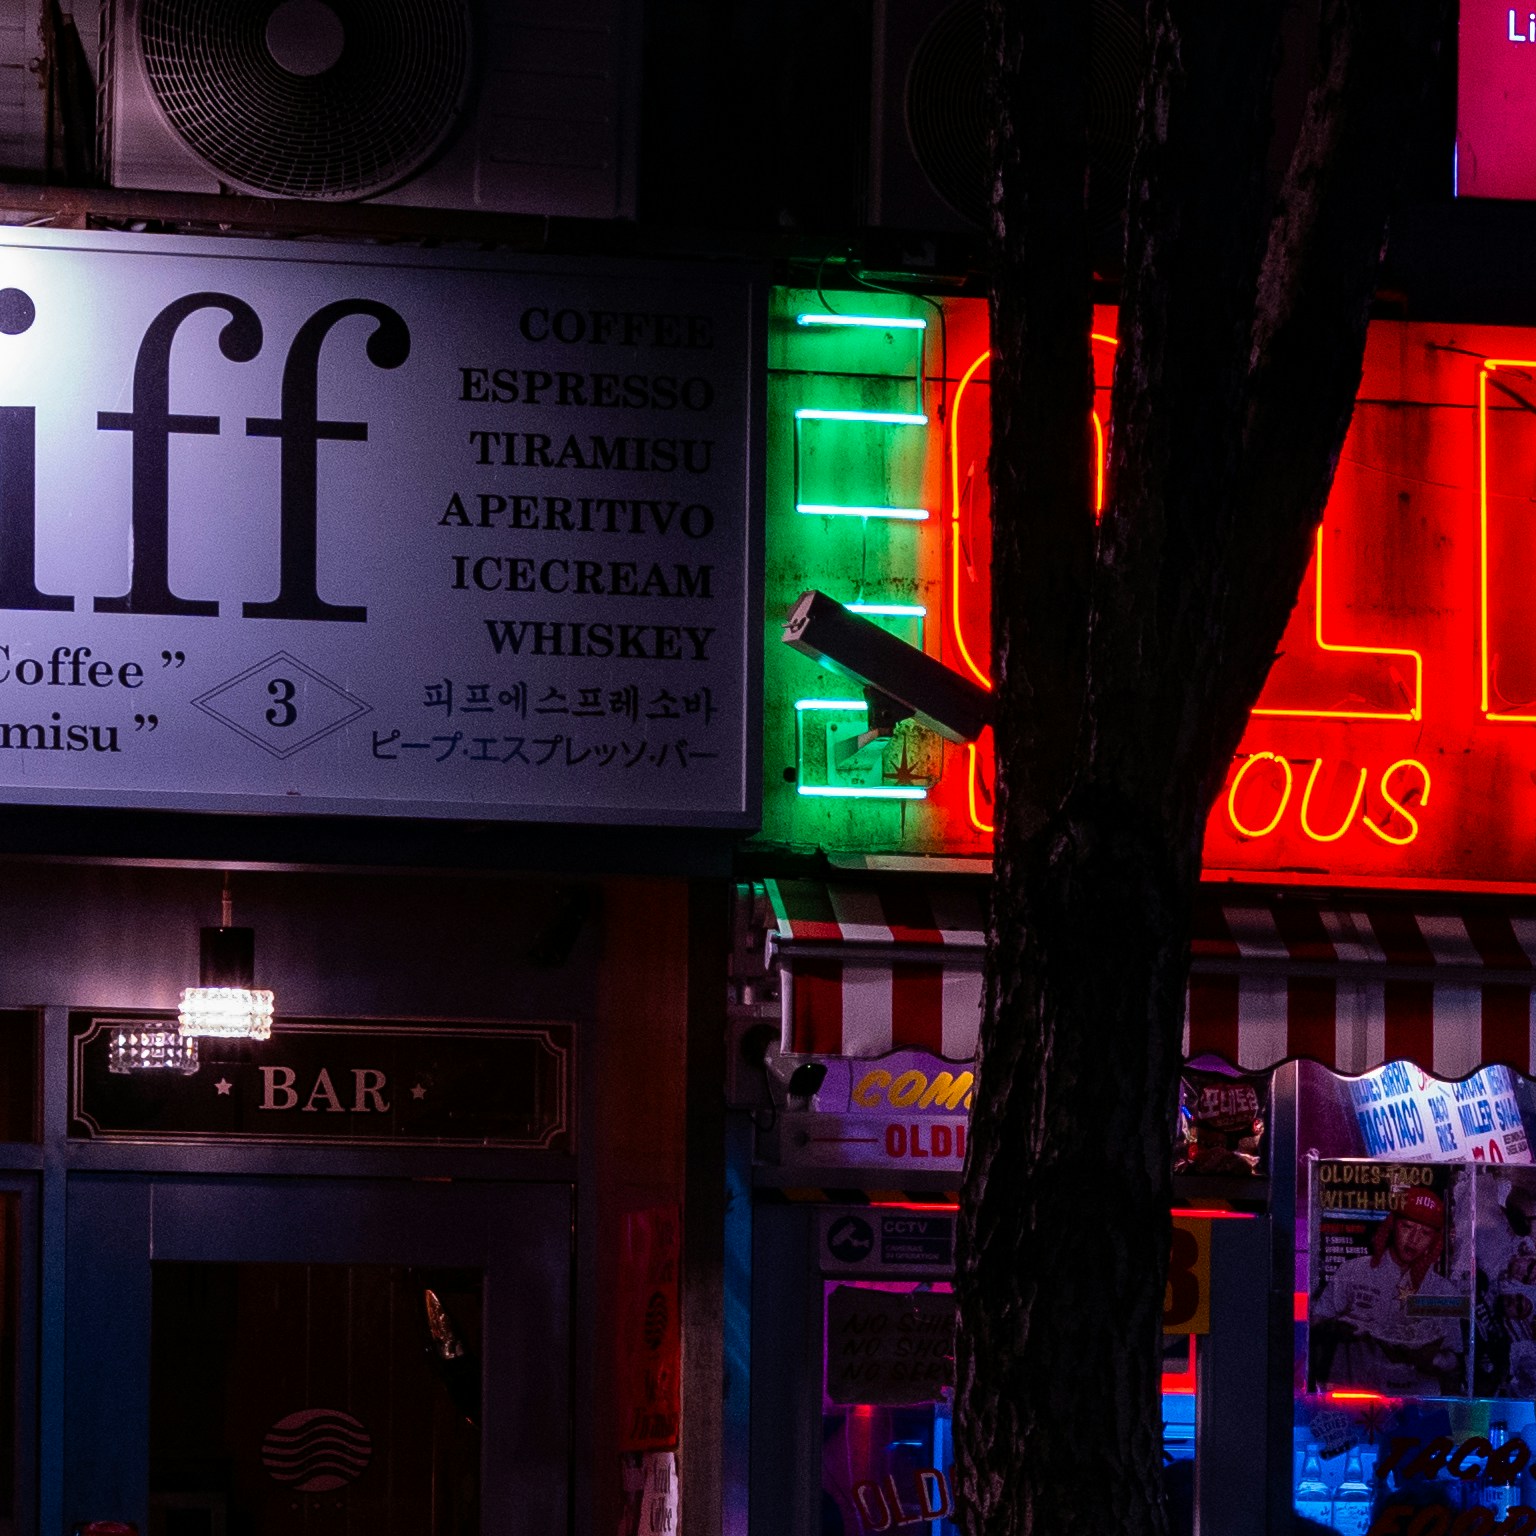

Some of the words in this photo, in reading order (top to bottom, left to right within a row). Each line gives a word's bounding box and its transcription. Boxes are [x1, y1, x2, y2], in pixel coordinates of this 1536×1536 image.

[518, 305, 715, 350] COFFEE
[457, 366, 715, 412] ESPRESSO
[469, 430, 715, 474] TIRAMISU
[438, 492, 715, 540] APERITIVO
[451, 555, 715, 599] ICECREAM
[485, 619, 715, 662] WHISKEY
[265, 678, 297, 727] 3
[259, 1066, 391, 1113] BAR
[852, 1069, 974, 1111] COM
[1319, 1164, 1381, 1186] OLDIES
[1319, 1189, 1370, 1210] WITH
[883, 1220, 929, 1235] CCTV
[842, 1312, 888, 1334] NO
[842, 1337, 882, 1357] NO
[841, 1361, 880, 1381] NO
[852, 1465, 955, 1533] OLD
